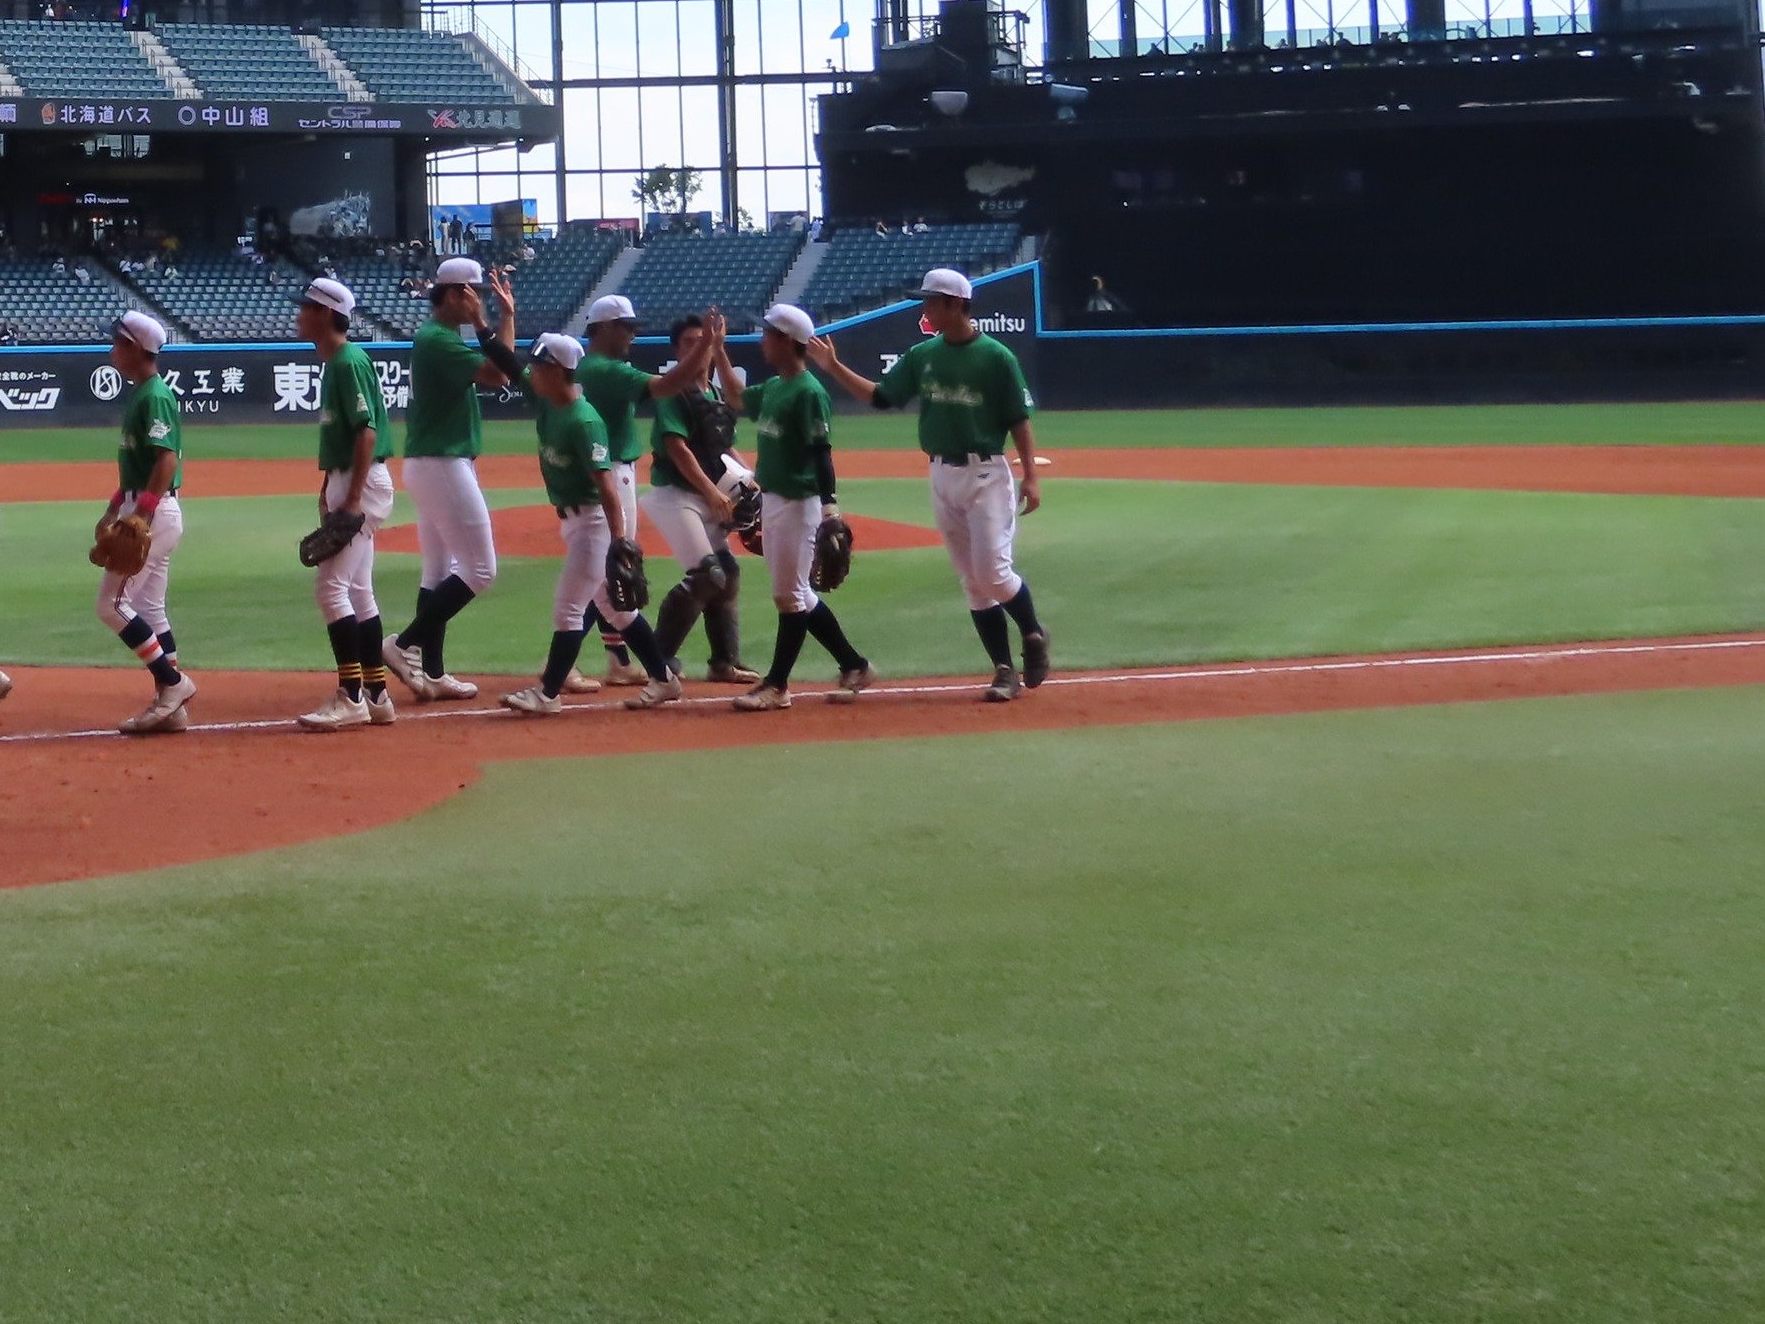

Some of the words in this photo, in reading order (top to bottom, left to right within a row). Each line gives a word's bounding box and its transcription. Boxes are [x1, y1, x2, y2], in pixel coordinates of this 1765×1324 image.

[60, 105, 152, 125] 北海道バス
[201, 106, 270, 126] 中山組
[970, 312, 1026, 332] emitsu
